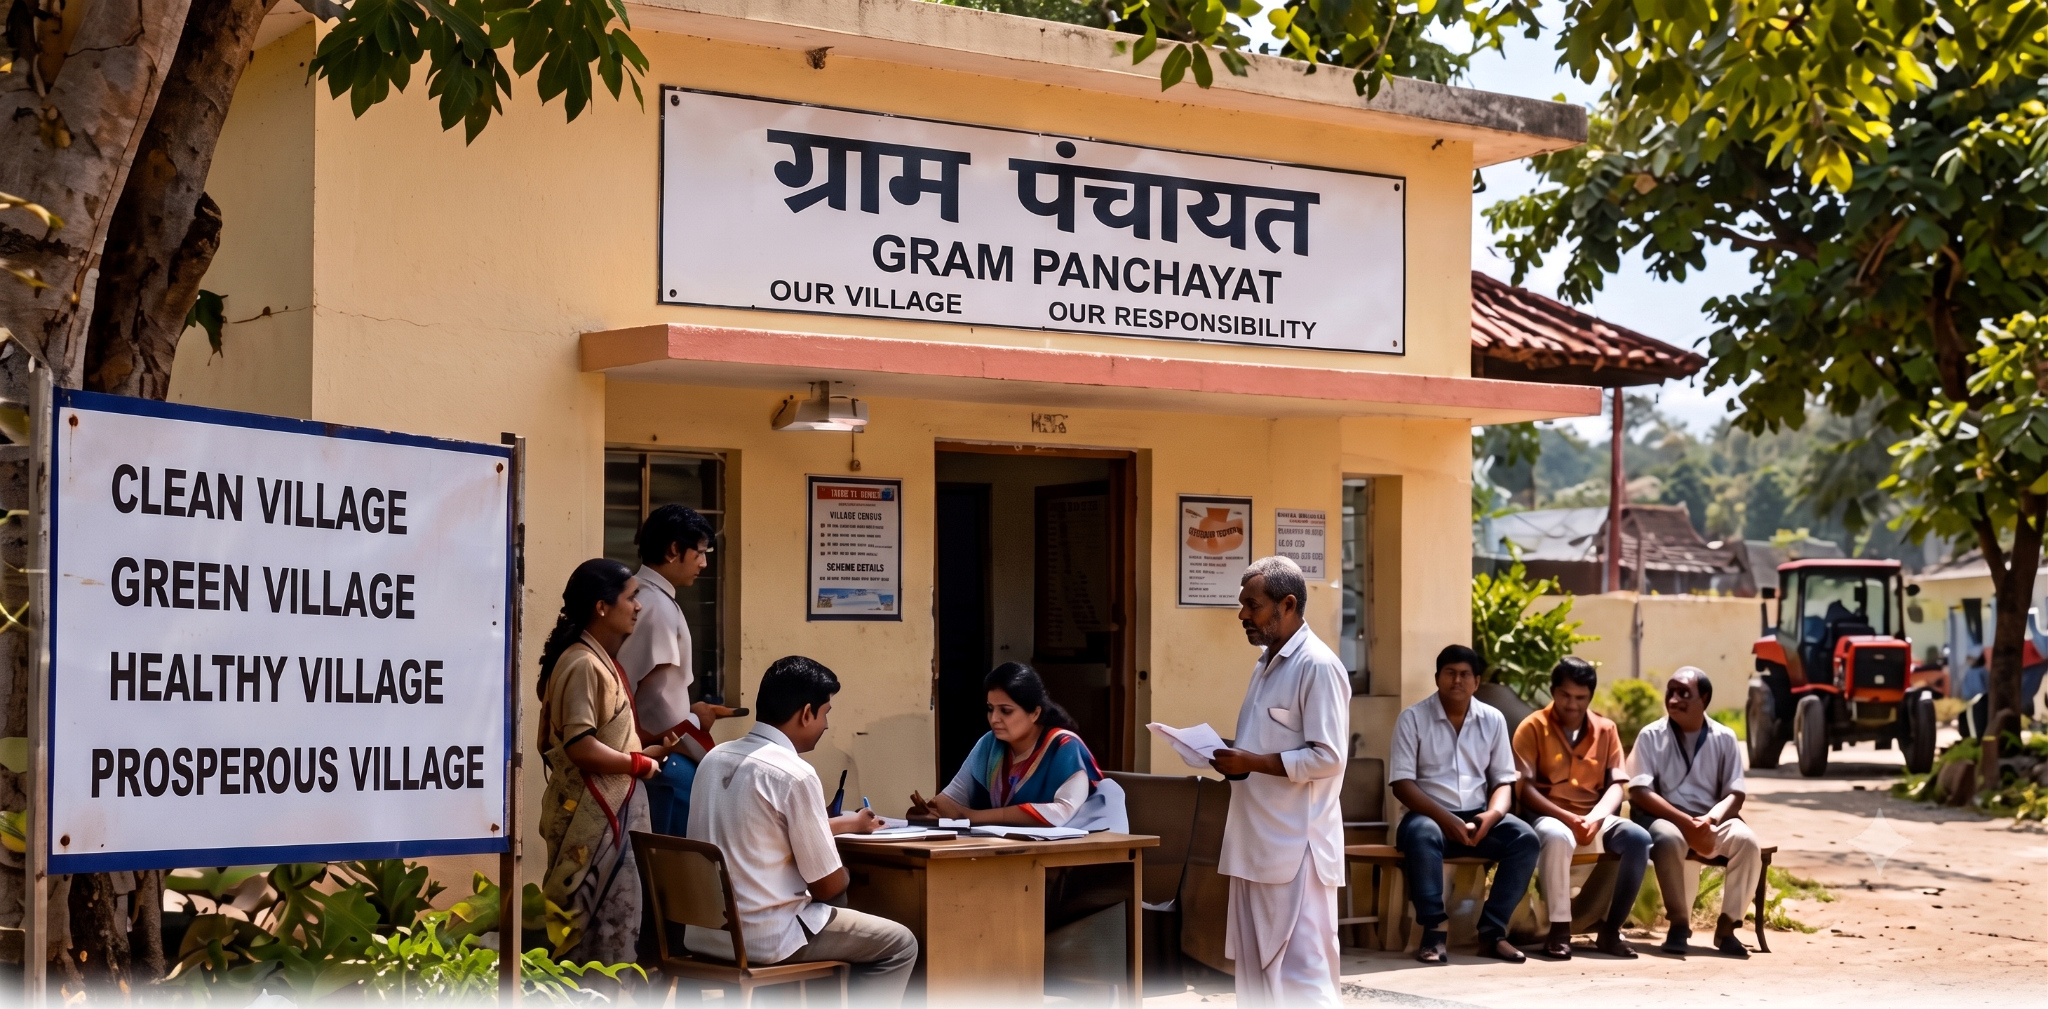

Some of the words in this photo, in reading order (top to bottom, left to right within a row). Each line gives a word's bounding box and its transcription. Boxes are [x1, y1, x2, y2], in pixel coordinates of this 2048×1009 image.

[766, 128, 972, 224] ग्राम
[1008, 140, 1321, 257] पंचायत
[872, 234, 1014, 283] GRAM
[1033, 248, 1282, 305] PANCHAYAT
[770, 279, 836, 305] OUR
[844, 284, 962, 315] VILLAGE
[1048, 301, 1106, 325] OUR
[1115, 306, 1317, 340] RESPONSIBILITY
[111, 463, 244, 522] CLEAN
[256, 476, 408, 535] VILLAGE
[829, 511, 856, 520] VILLAGE
[857, 512, 882, 521] CENSUS
[111, 556, 250, 612] GREEN
[262, 566, 415, 620] VILLAGE
[110, 651, 289, 703] HEALTHY
[298, 656, 444, 705] VILLAGE
[91, 747, 339, 799] PROSPEROUS
[348, 745, 484, 792] VILLAGE
